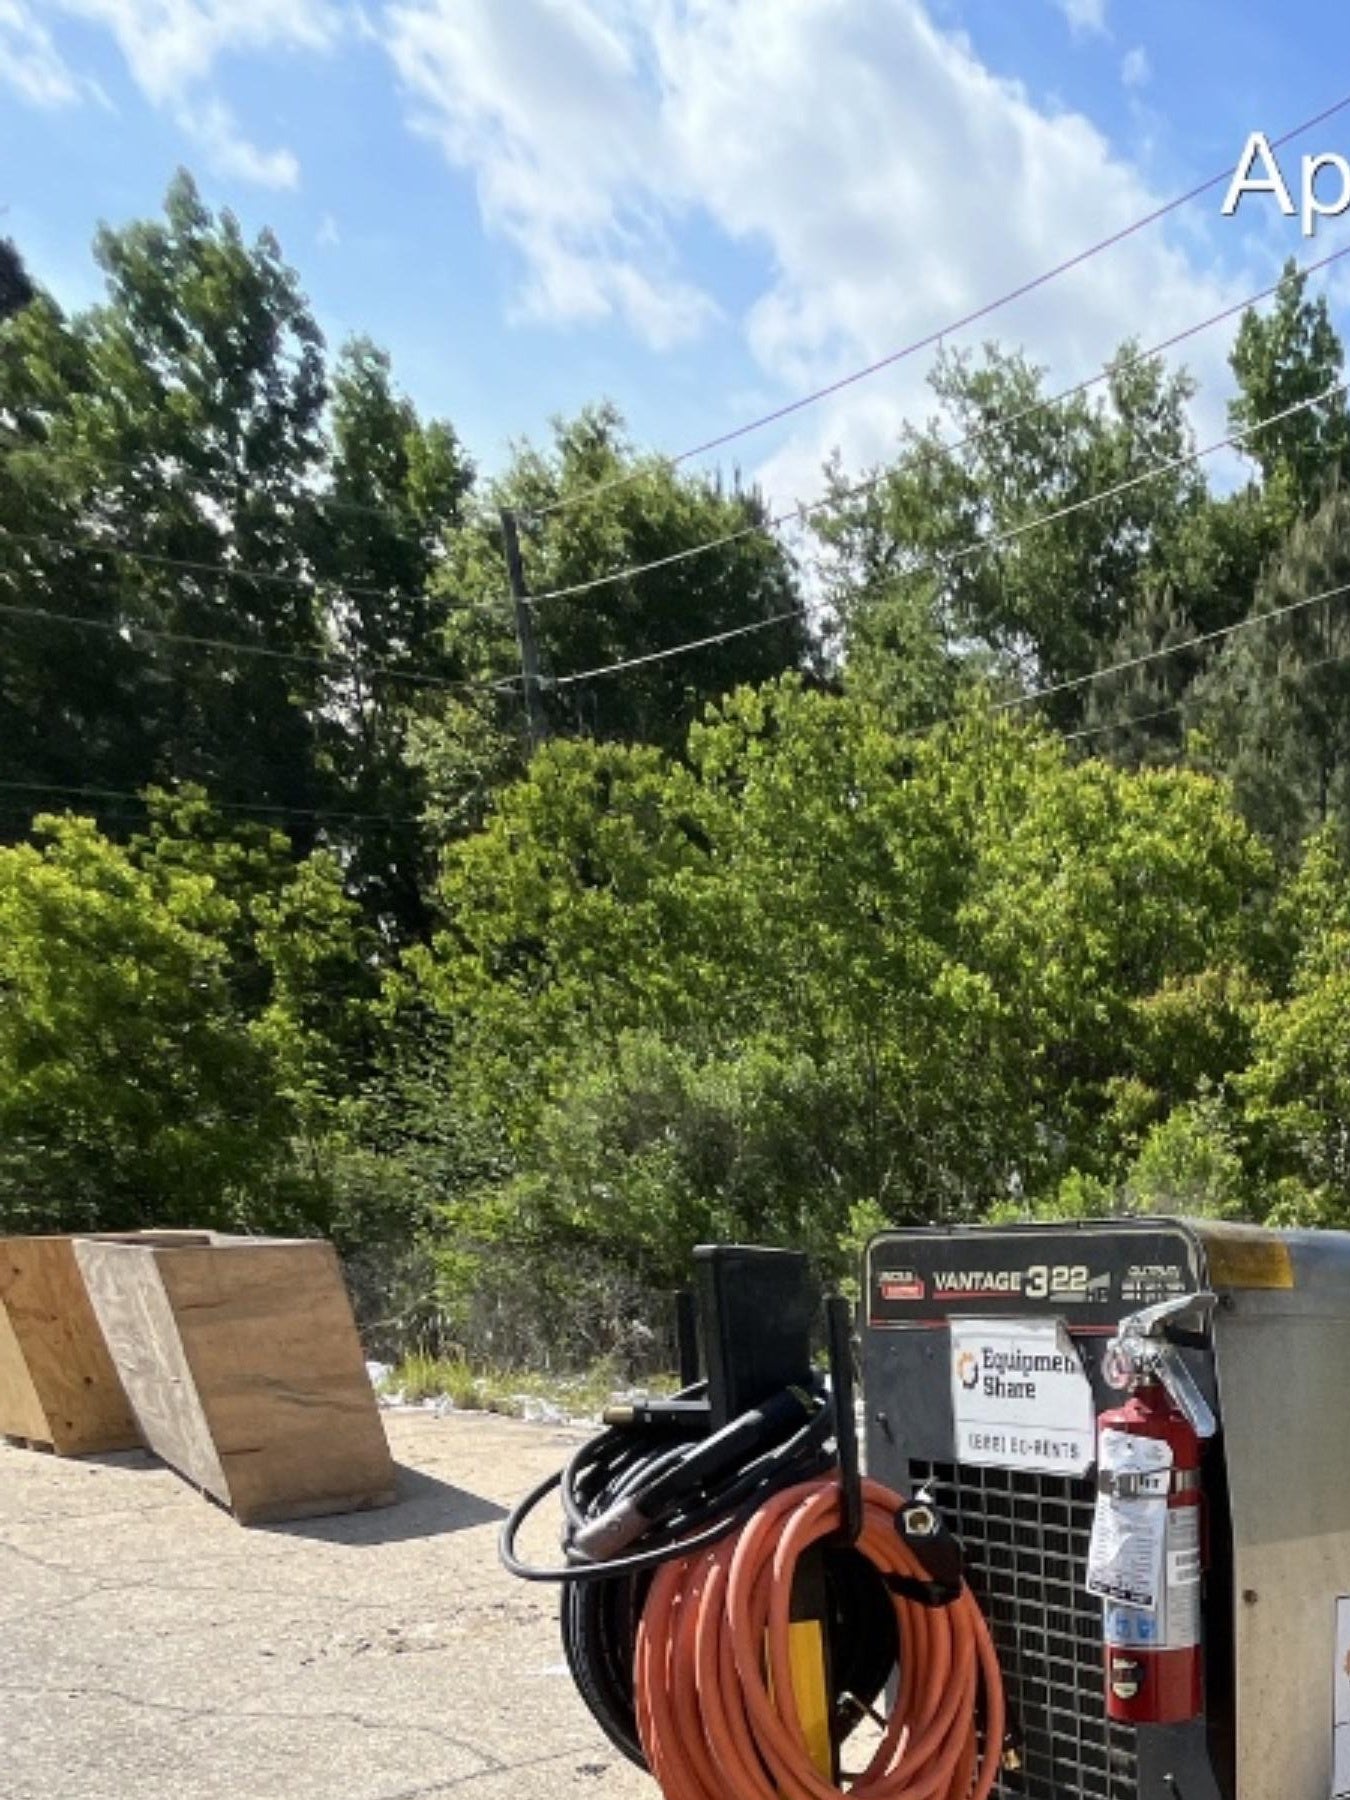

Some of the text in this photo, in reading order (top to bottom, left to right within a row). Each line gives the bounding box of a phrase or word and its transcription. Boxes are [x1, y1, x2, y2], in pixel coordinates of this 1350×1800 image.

[932, 1270, 1022, 1292] VANTAGE
[1025, 1264, 1088, 1299] 322
[981, 1346, 1076, 1377] Equipmen
[983, 1376, 1036, 1399] Share
